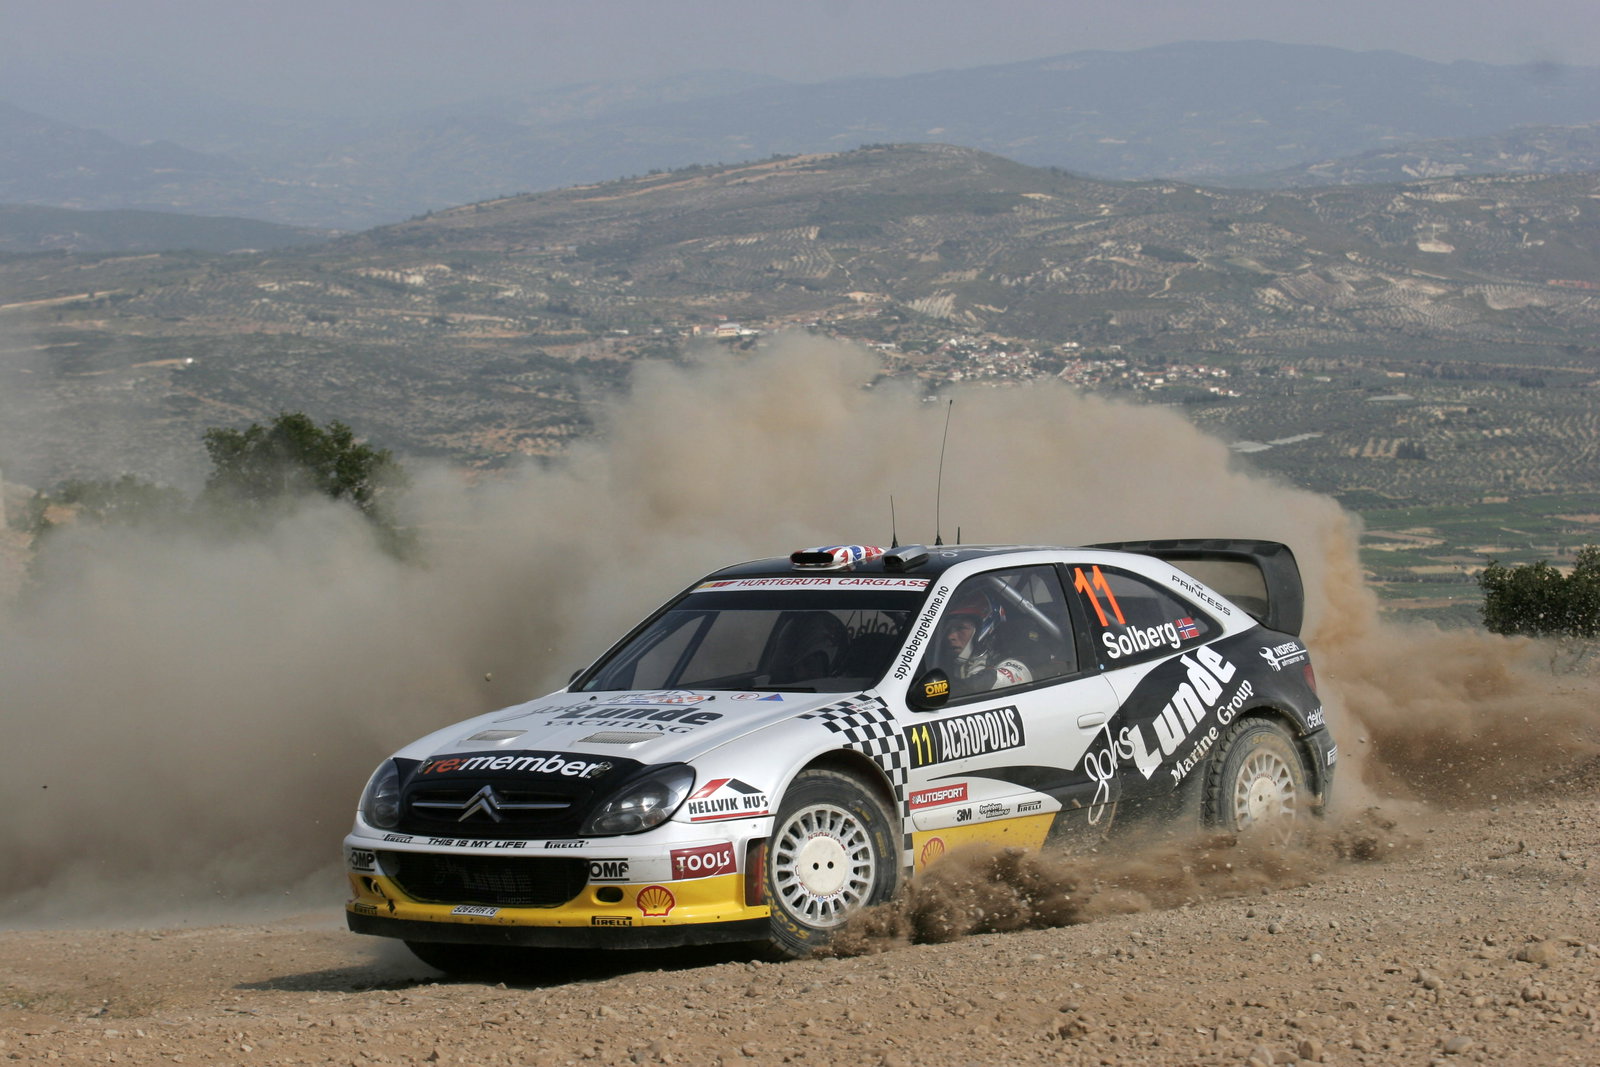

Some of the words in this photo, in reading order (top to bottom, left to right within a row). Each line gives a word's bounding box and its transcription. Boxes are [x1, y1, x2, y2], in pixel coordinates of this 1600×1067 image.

[737, 578, 832, 587] HURTIGRUTA
[837, 578, 930, 588] CARGLASS
[1073, 565, 1126, 627] 11
[1171, 574, 1231, 616] PRINCESS
[894, 585, 949, 680] spydebergreklame.no
[1102, 621, 1181, 659] Solberg
[1273, 641, 1300, 657] NORSK
[925, 681, 949, 695] OMP
[553, 707, 724, 726] Lunde
[1127, 644, 1237, 781] Lunde
[543, 720, 695, 734] YACHTING
[1170, 725, 1219, 787] Marine
[1217, 679, 1254, 727] Group
[911, 725, 933, 766] 11
[939, 708, 1020, 761] ACROPOLIS
[424, 754, 598, 778] re:member
[915, 786, 964, 804] AUTOSPORT
[688, 797, 739, 815] HELLVIK
[743, 795, 769, 809] HUS
[1017, 801, 1042, 813] PIRELLI
[956, 808, 972, 822] 3M
[383, 834, 413, 843] PIRELLI
[428, 838, 453, 847] THIS
[455, 839, 468, 847] IS
[470, 840, 493, 848] MY
[498, 841, 527, 849] LIFE!
[544, 840, 587, 849] PIRELLI
[590, 861, 630, 878] OMP
[676, 850, 731, 873] TOOLS
[591, 916, 633, 927] PIRELLI
